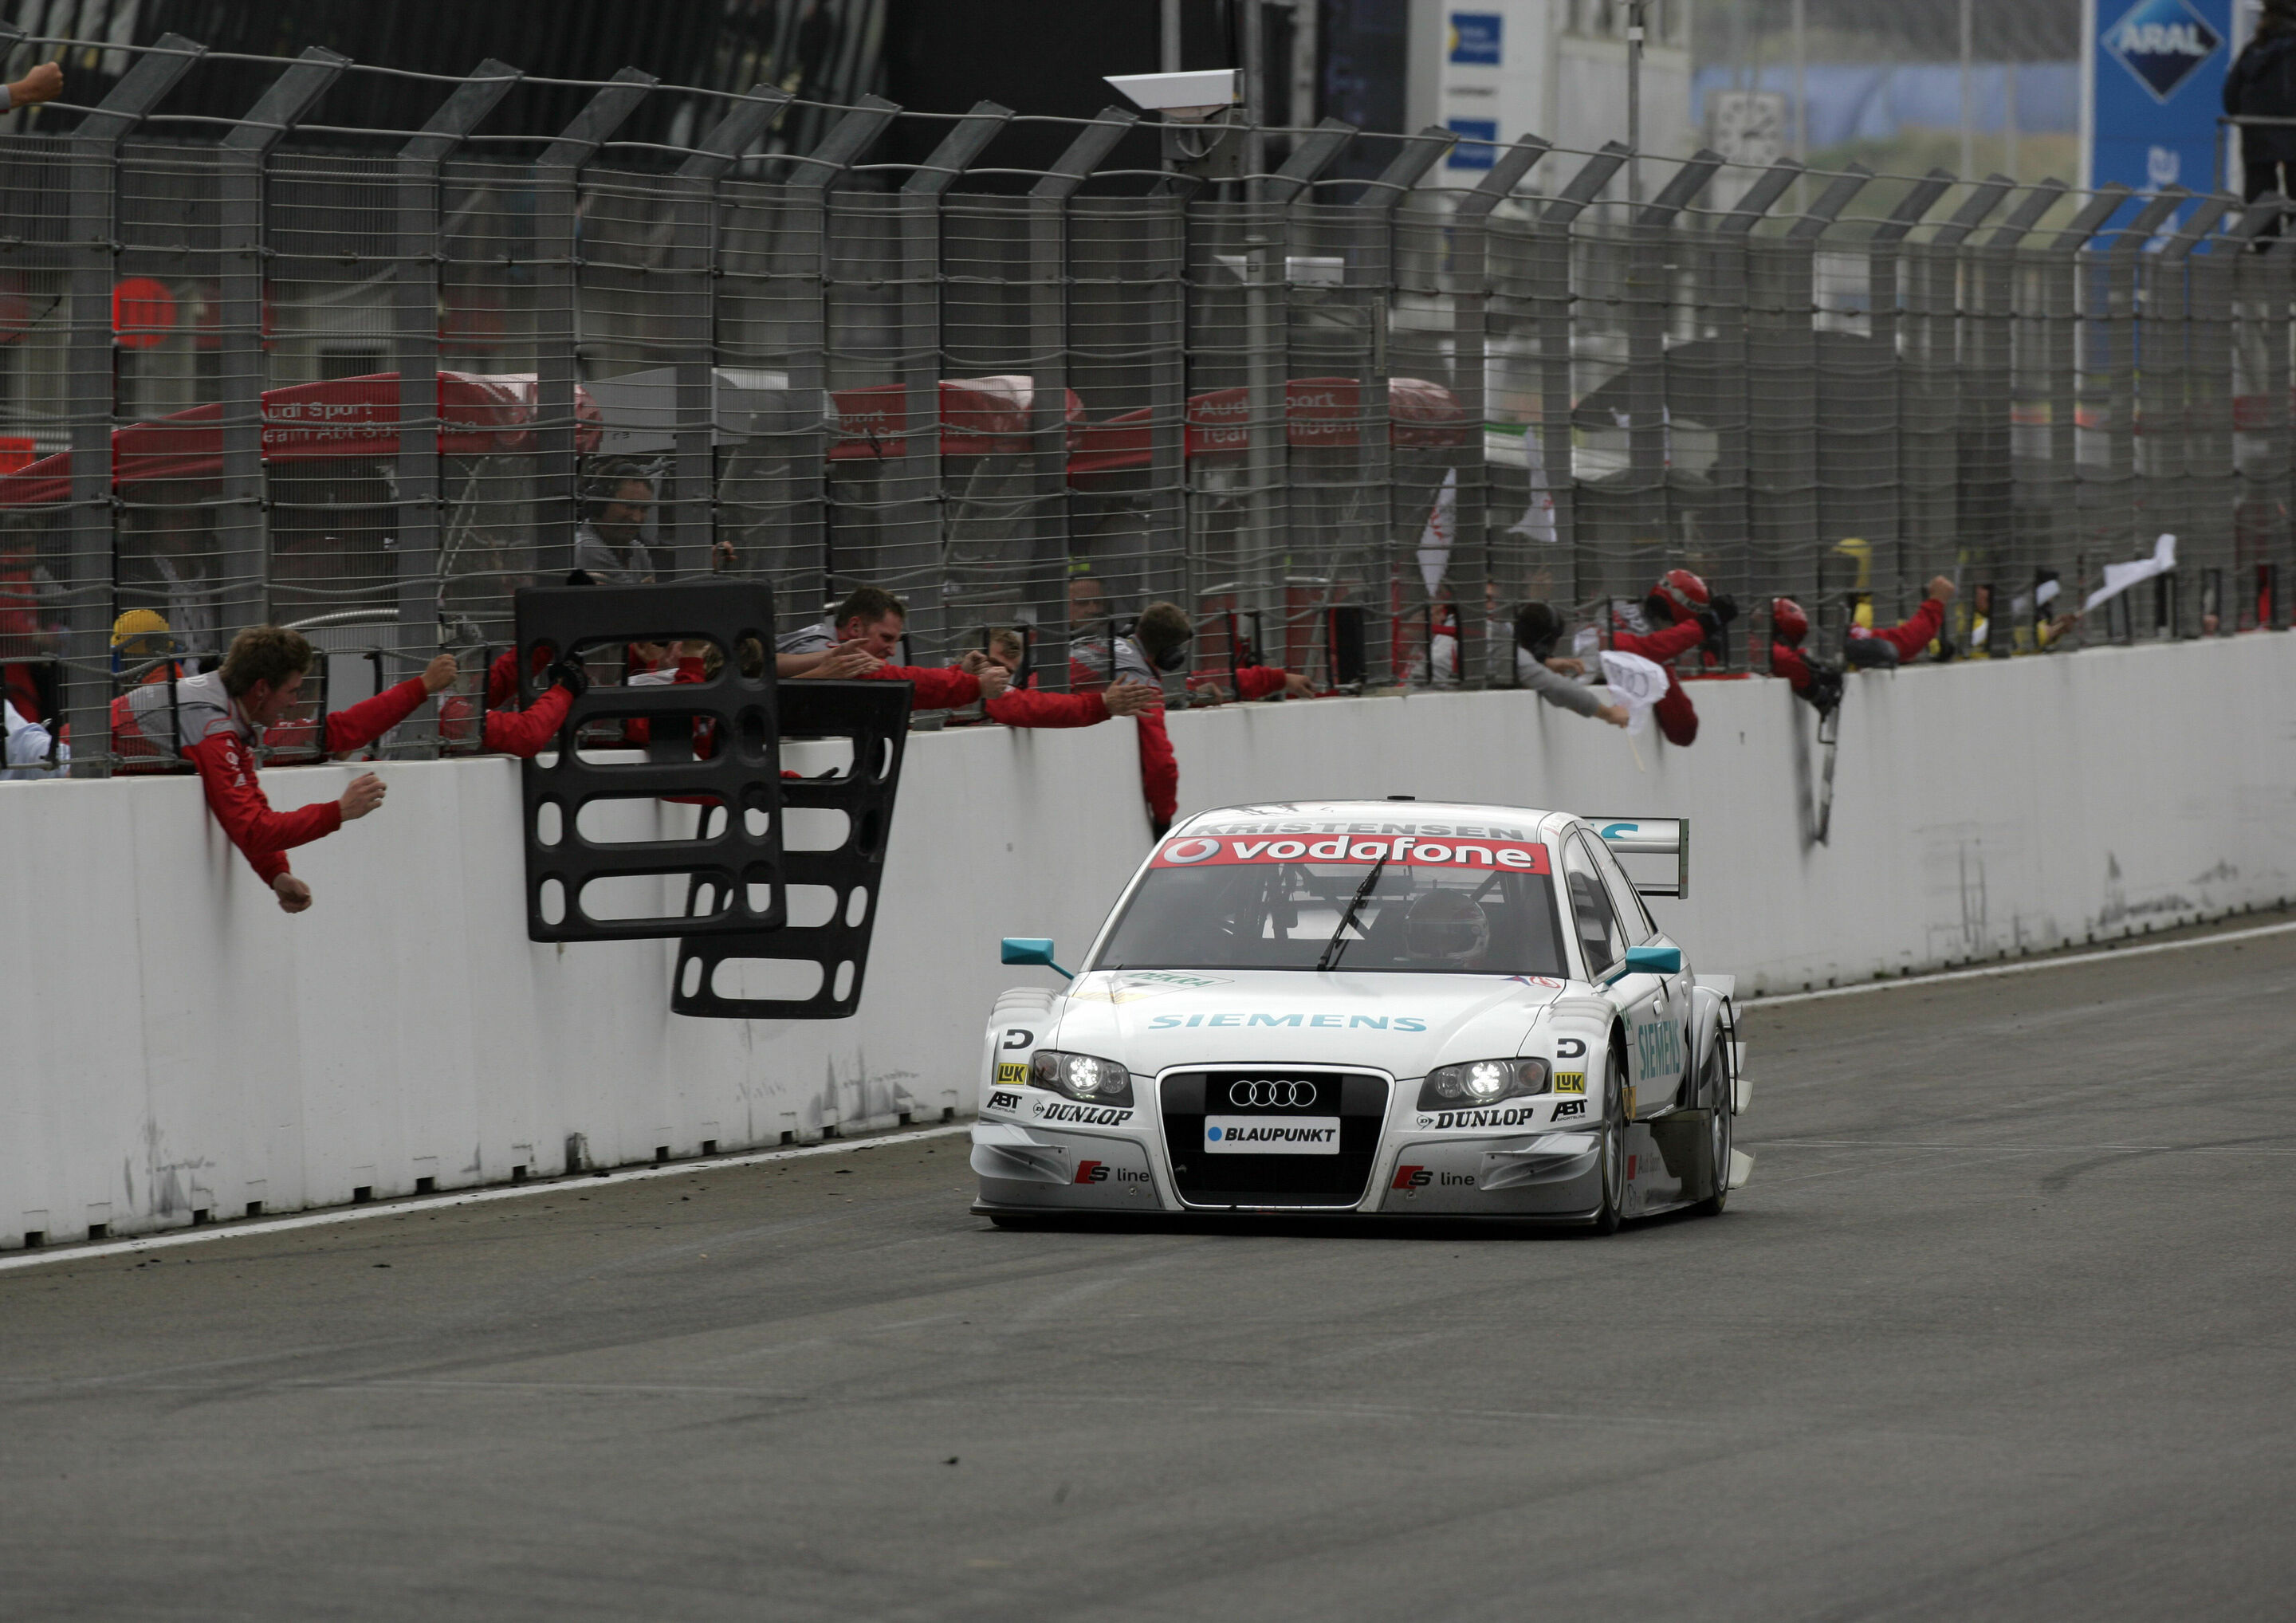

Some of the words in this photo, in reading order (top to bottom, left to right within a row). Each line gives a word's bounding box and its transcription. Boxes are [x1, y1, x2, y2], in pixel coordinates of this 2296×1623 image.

[2118, 22, 2208, 54] ARAL
[308, 402, 373, 419] Sport
[1198, 399, 1249, 416] Aud
[262, 427, 311, 442] eam
[1193, 822, 1524, 840] KRISTENSEN
[1233, 835, 1532, 869] vodafone
[1126, 972, 1214, 987] DEKRA
[1148, 1013, 1427, 1032] SIEMENS
[1638, 1018, 1681, 1081] SIEMENS
[987, 1091, 1022, 1109] ABT
[1043, 1103, 1133, 1126] DUNLOP
[1435, 1108, 1534, 1129] DUNLOP
[1550, 1099, 1588, 1122] ABT
[1225, 1127, 1336, 1142] BLAUPUNKT
[1088, 1166, 1110, 1182] S
[1117, 1168, 1150, 1183] line
[1409, 1171, 1433, 1186] S
[1441, 1171, 1475, 1186] line
